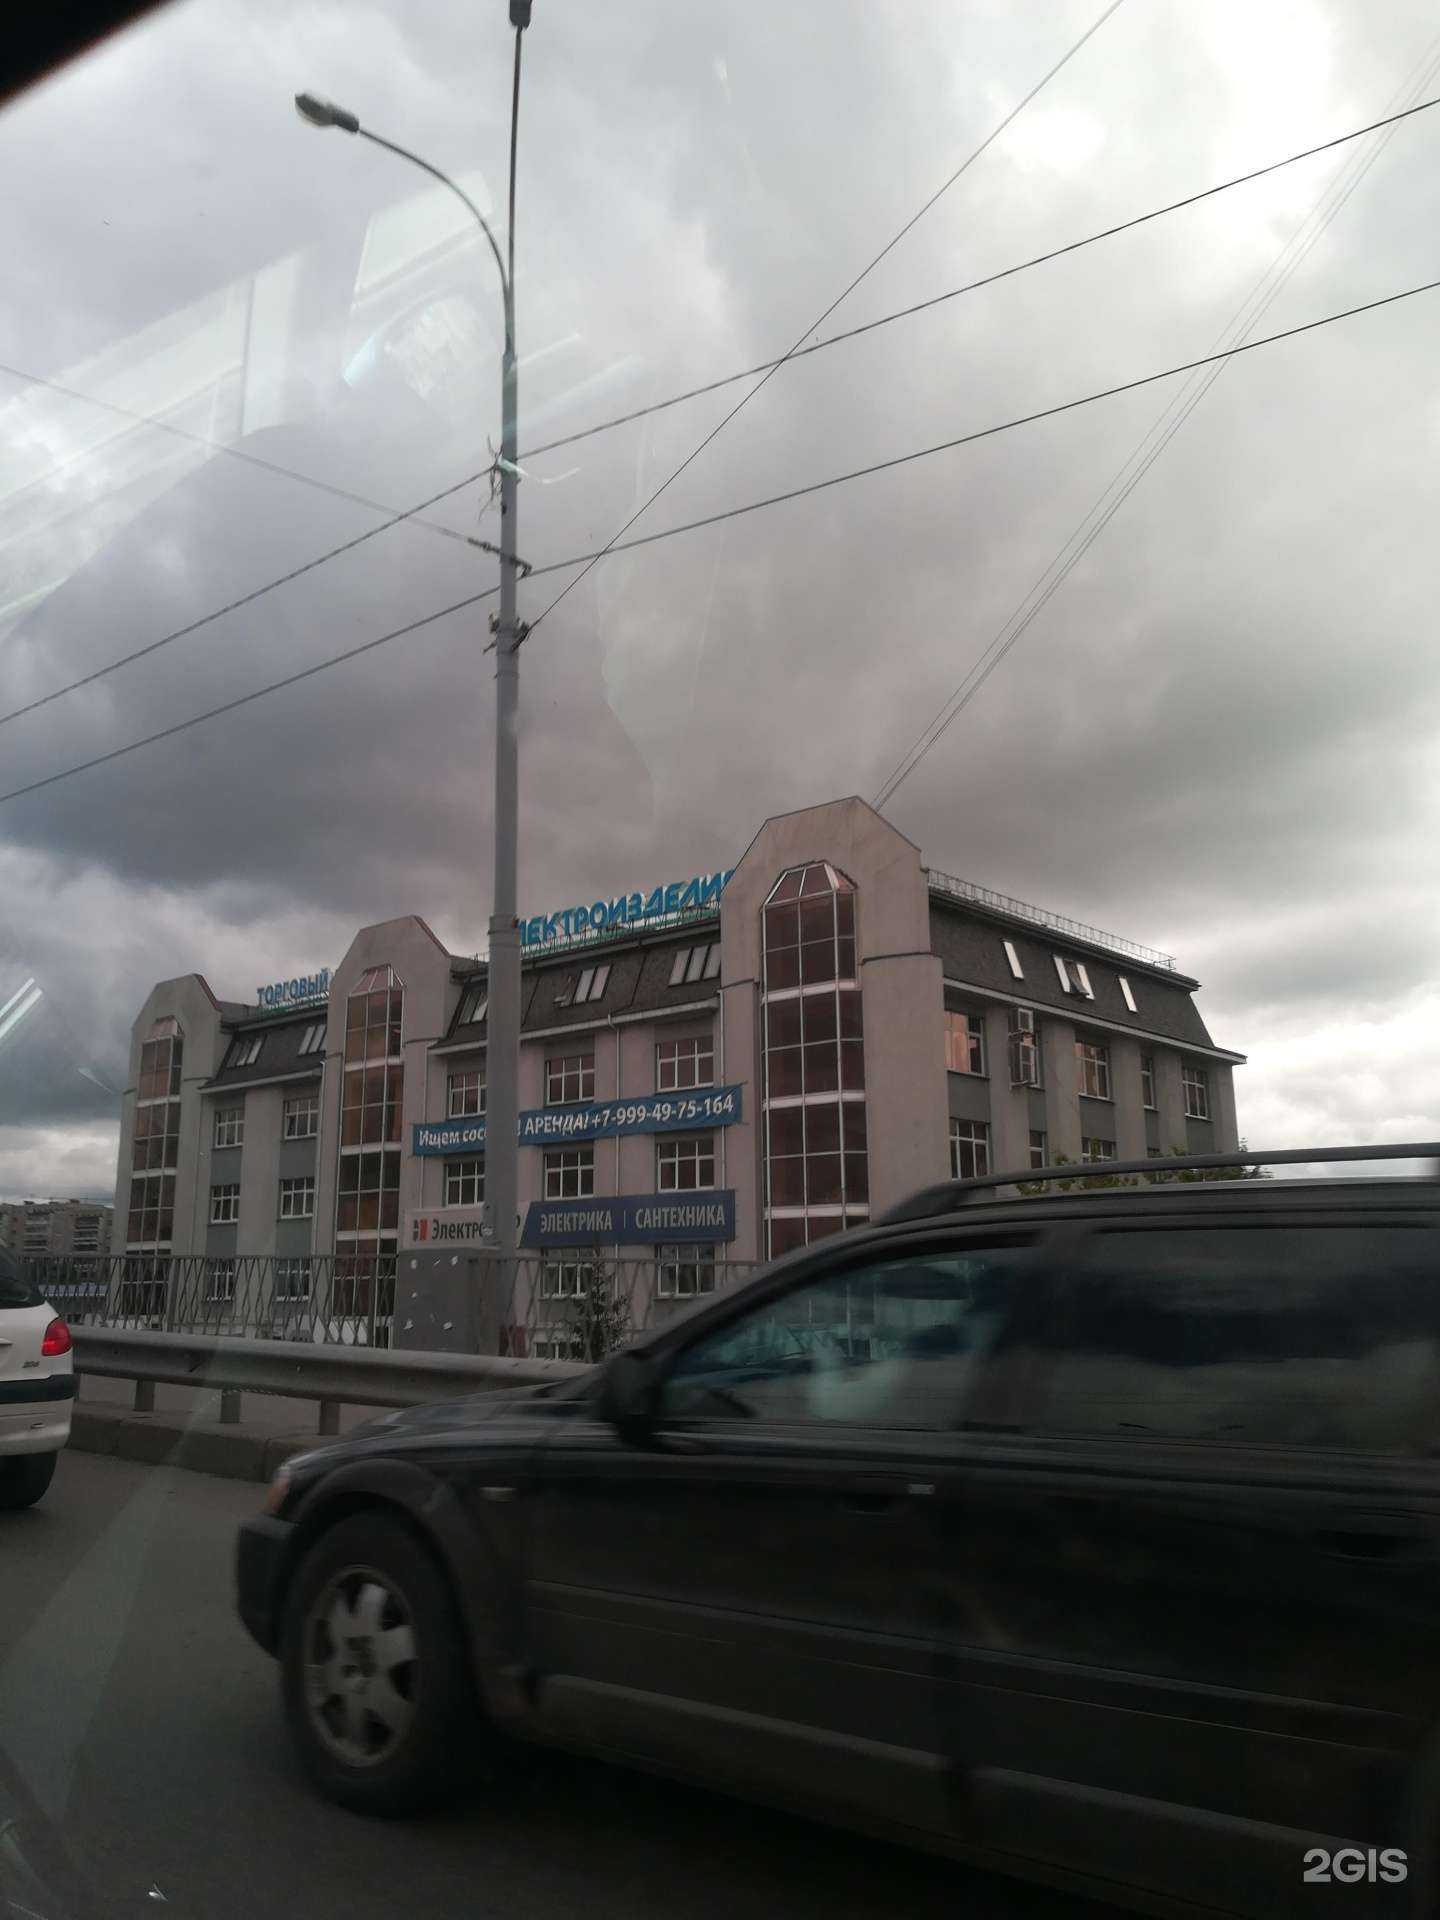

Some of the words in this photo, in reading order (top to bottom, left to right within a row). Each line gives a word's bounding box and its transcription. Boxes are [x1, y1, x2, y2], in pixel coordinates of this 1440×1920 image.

[257, 967, 329, 1007] ТОРГОВЫЙ
[419, 1130, 460, 1148] Ищем
[525, 1112, 588, 1137] АРЕНДА!
[591, 1094, 734, 1129] +7-999-49-75-164
[540, 1210, 613, 1233] ЭЛЕКТРИКА
[635, 1205, 726, 1229] САНТЕХНИКА
